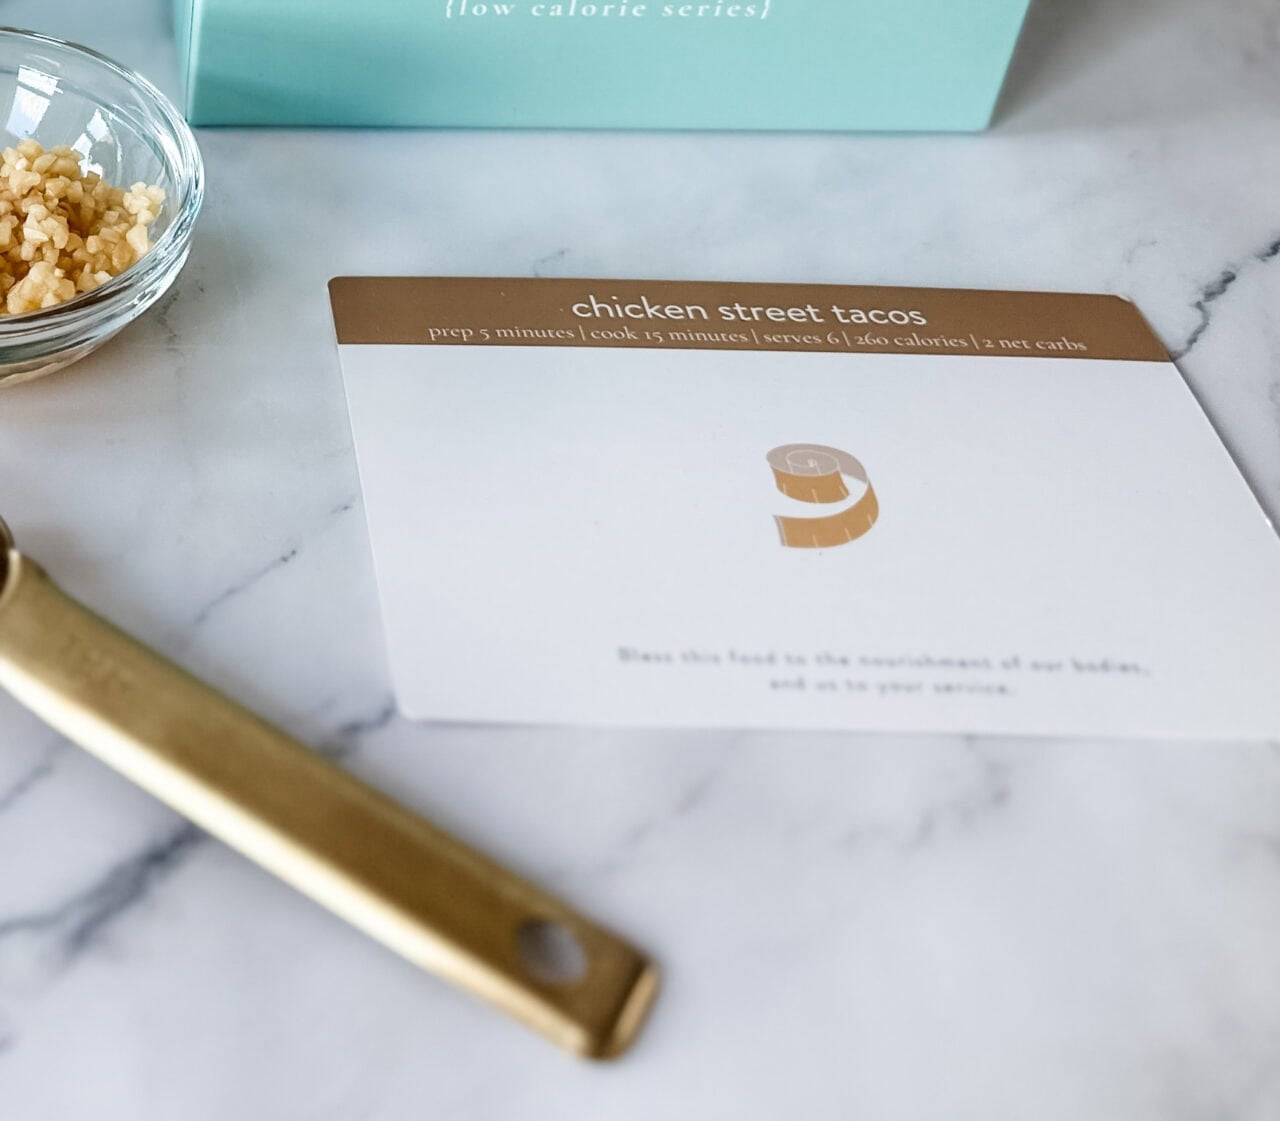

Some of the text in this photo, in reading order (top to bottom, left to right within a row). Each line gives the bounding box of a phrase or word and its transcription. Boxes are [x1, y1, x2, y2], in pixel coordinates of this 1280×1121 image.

[571, 295, 928, 326] chicken street tacos
[428, 326, 1088, 352] prep 5 minutes cook 15 minutes serves 6 260 calories 2 net carbs
